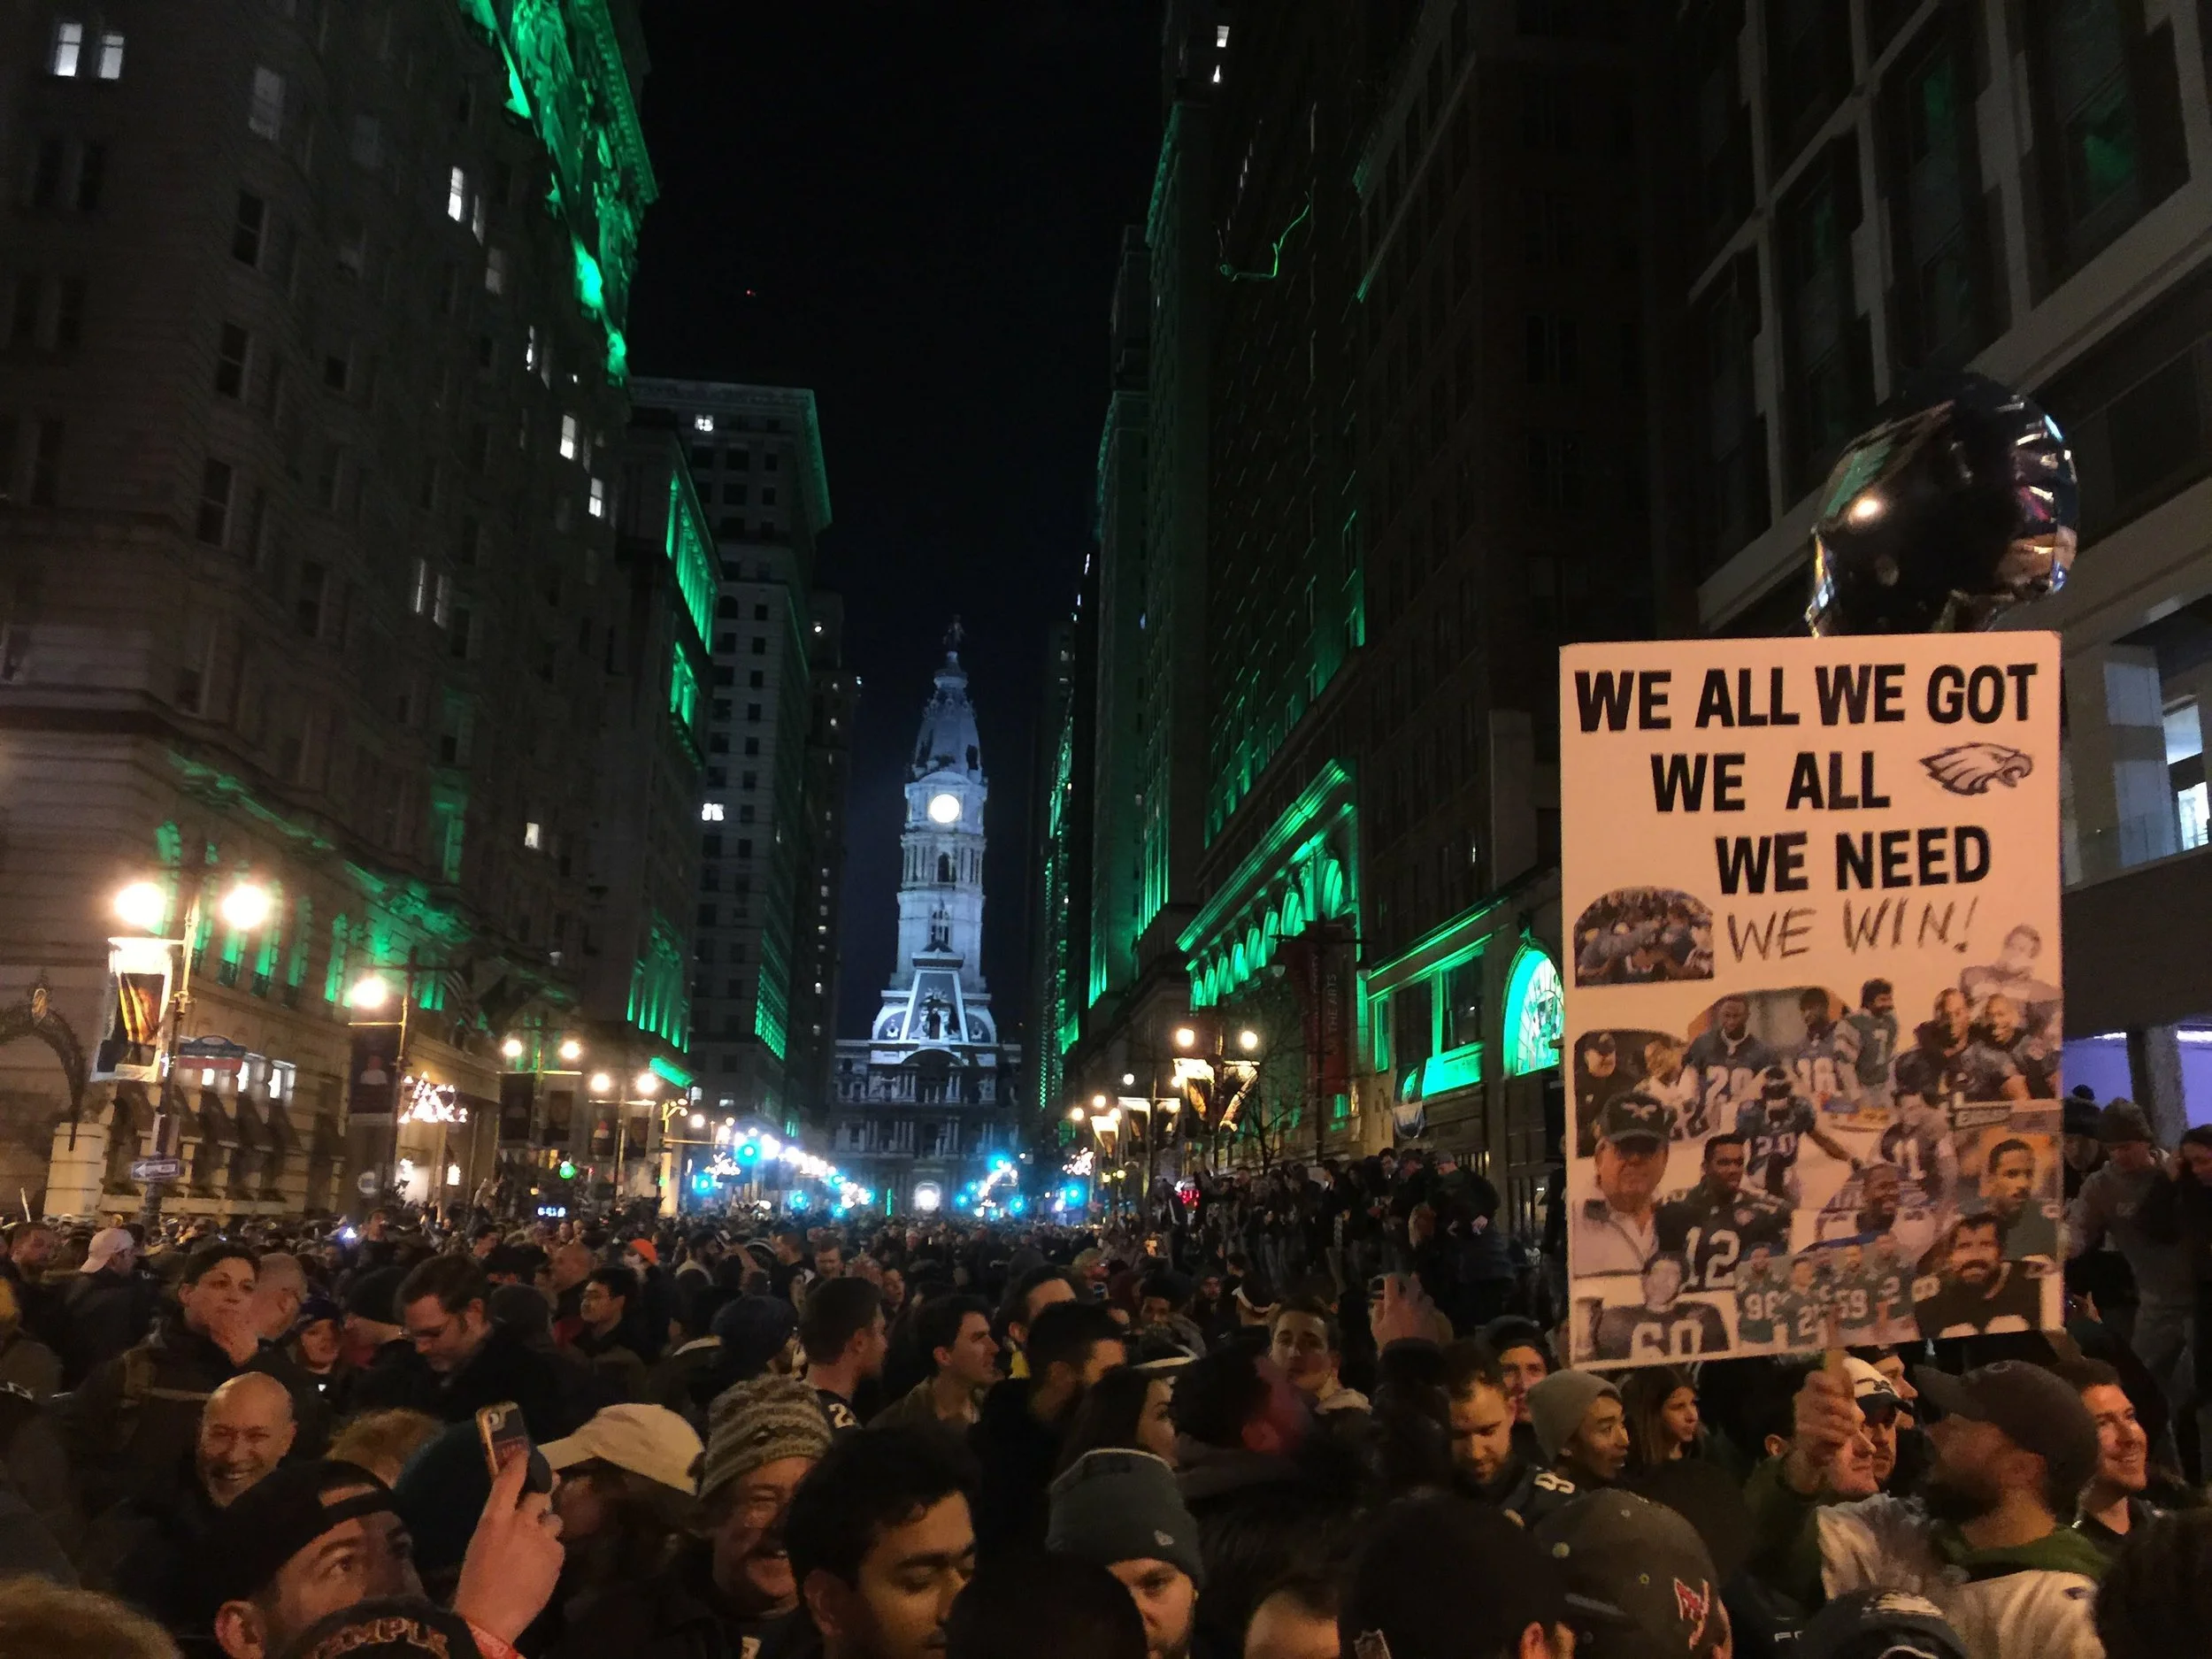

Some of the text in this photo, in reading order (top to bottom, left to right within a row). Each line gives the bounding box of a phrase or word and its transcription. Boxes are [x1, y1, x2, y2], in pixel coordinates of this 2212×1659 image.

[1574, 663, 2039, 734] WE ALL WE GOT
[1649, 749, 1892, 814] WE ALL
[1714, 825, 1993, 895] WE NEED
[1727, 895, 1978, 963] WE WIN!
[1326, 972, 1339, 1006] ARTS
[1686, 1226, 1741, 1289] 12
